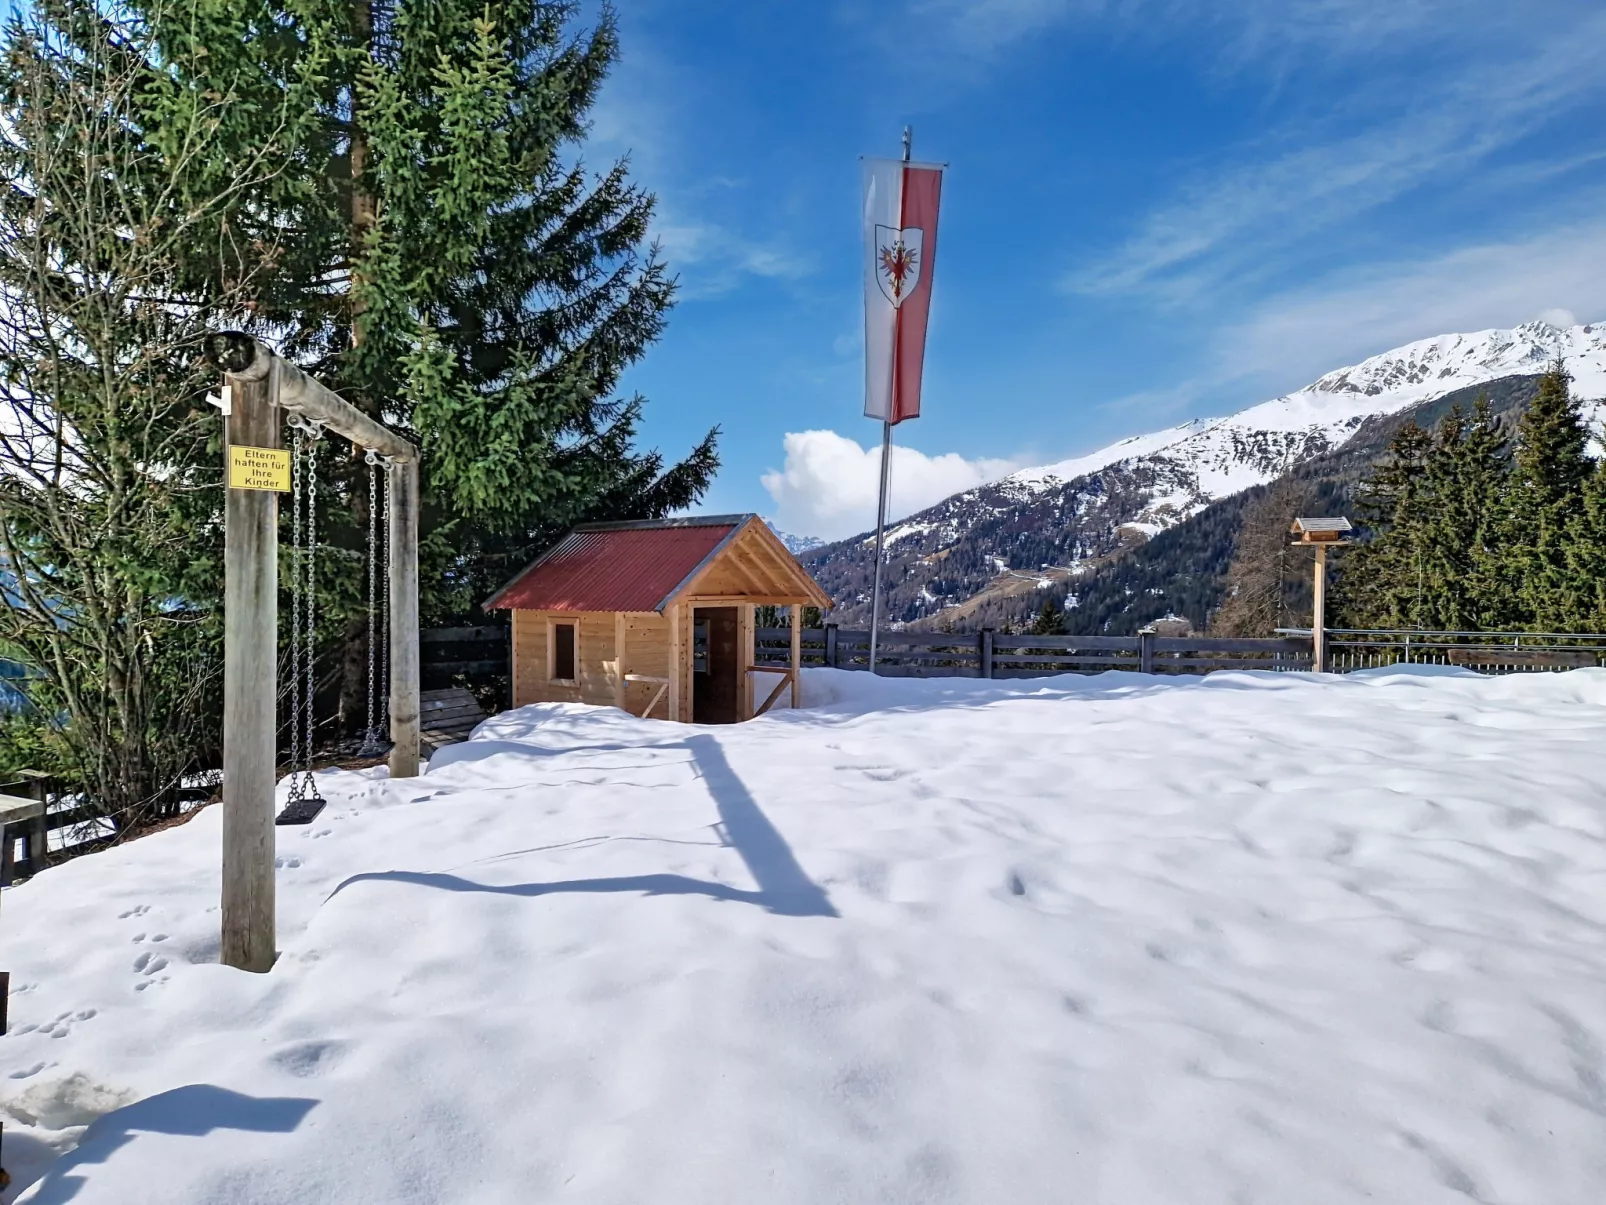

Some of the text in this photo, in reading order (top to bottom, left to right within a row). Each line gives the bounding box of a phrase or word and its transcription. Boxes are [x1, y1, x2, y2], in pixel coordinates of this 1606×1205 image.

[245, 450, 276, 459] Eltern
[234, 458, 285, 470] haften für
[252, 469, 273, 477] Ihre
[244, 477, 280, 487] Kinder
